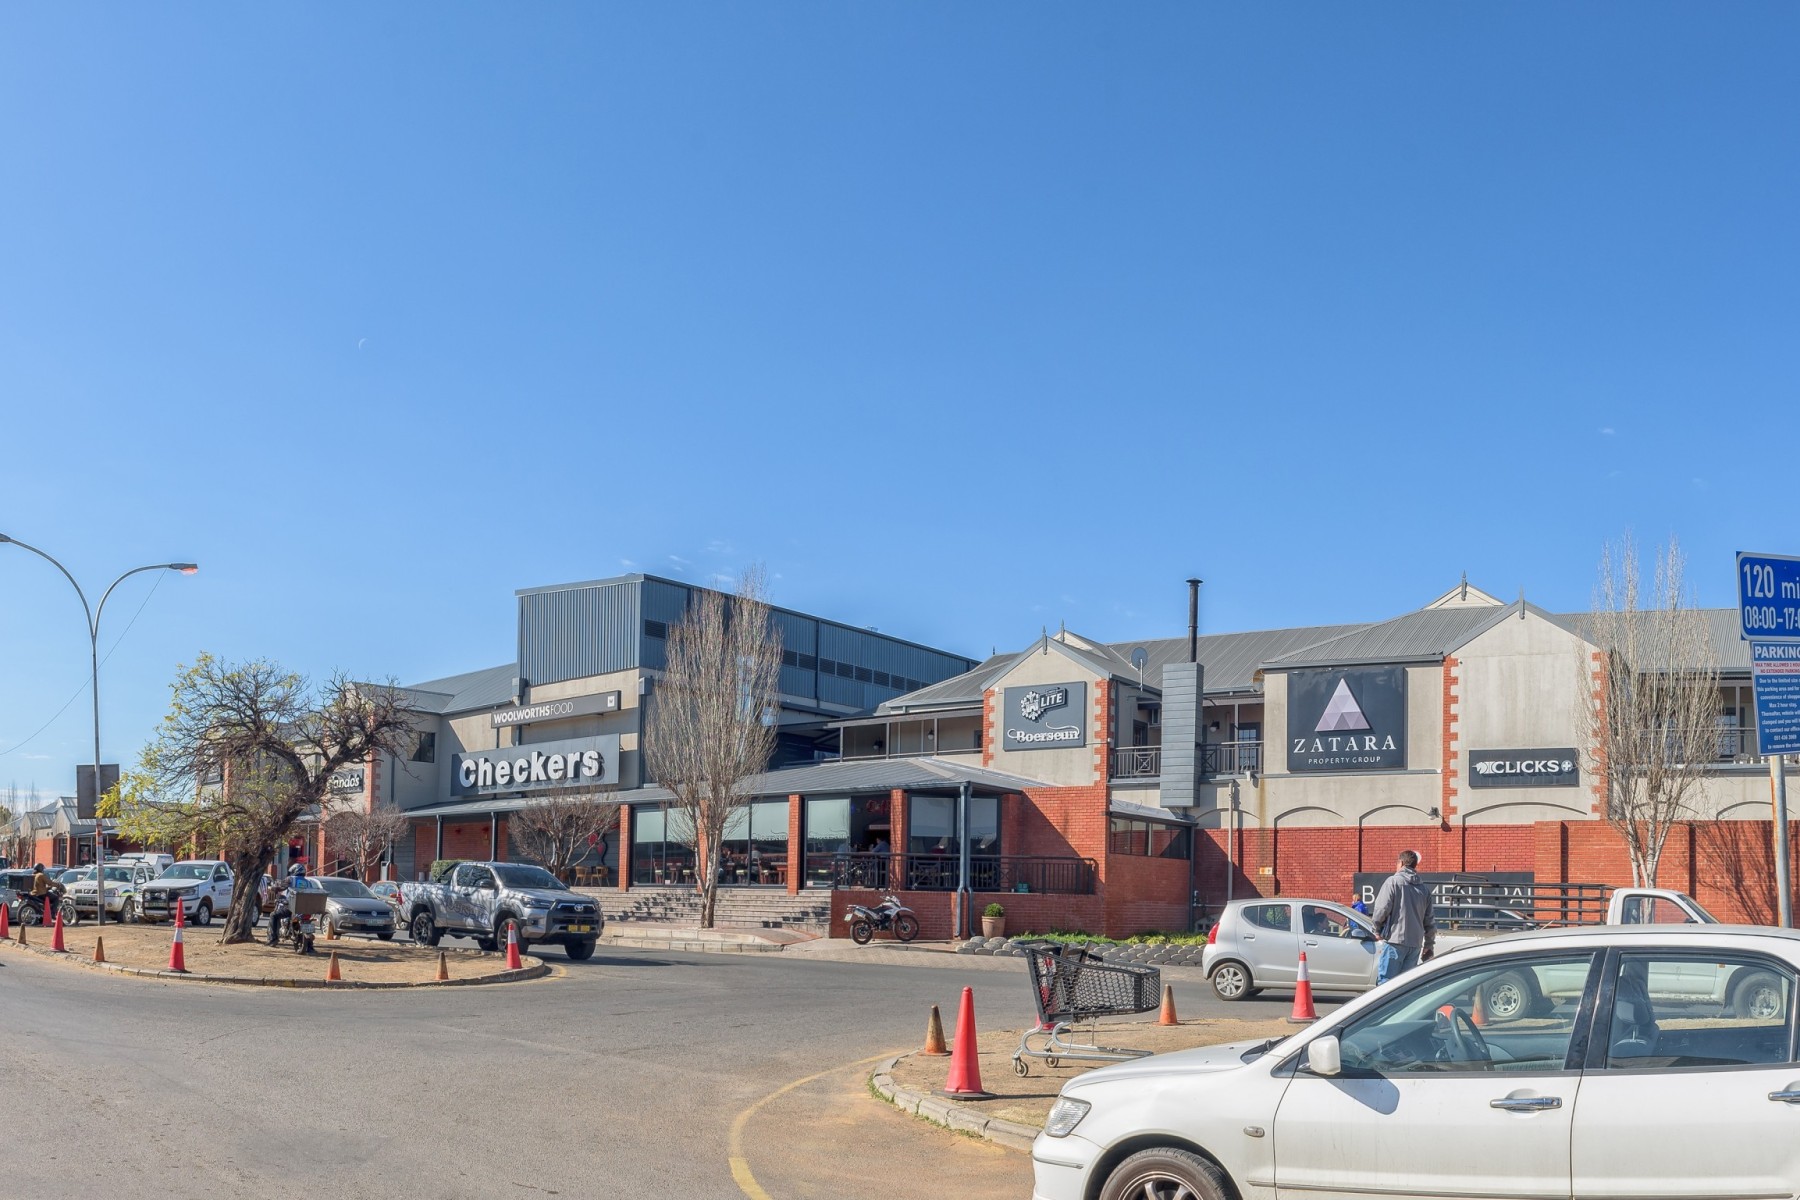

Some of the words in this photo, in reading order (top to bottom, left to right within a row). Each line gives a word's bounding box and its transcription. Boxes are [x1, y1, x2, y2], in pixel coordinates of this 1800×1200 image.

[1744, 563, 1775, 598] 120
[1041, 692, 1063, 707] LITE
[1009, 728, 1080, 742] Boerseun
[1293, 734, 1397, 753] ZATARA
[1308, 757, 1350, 765] PROPERTY
[1352, 756, 1381, 764] GROUP
[1491, 760, 1560, 775] CLICKS
[459, 750, 600, 788] Checkers
[330, 773, 360, 788] ando's
